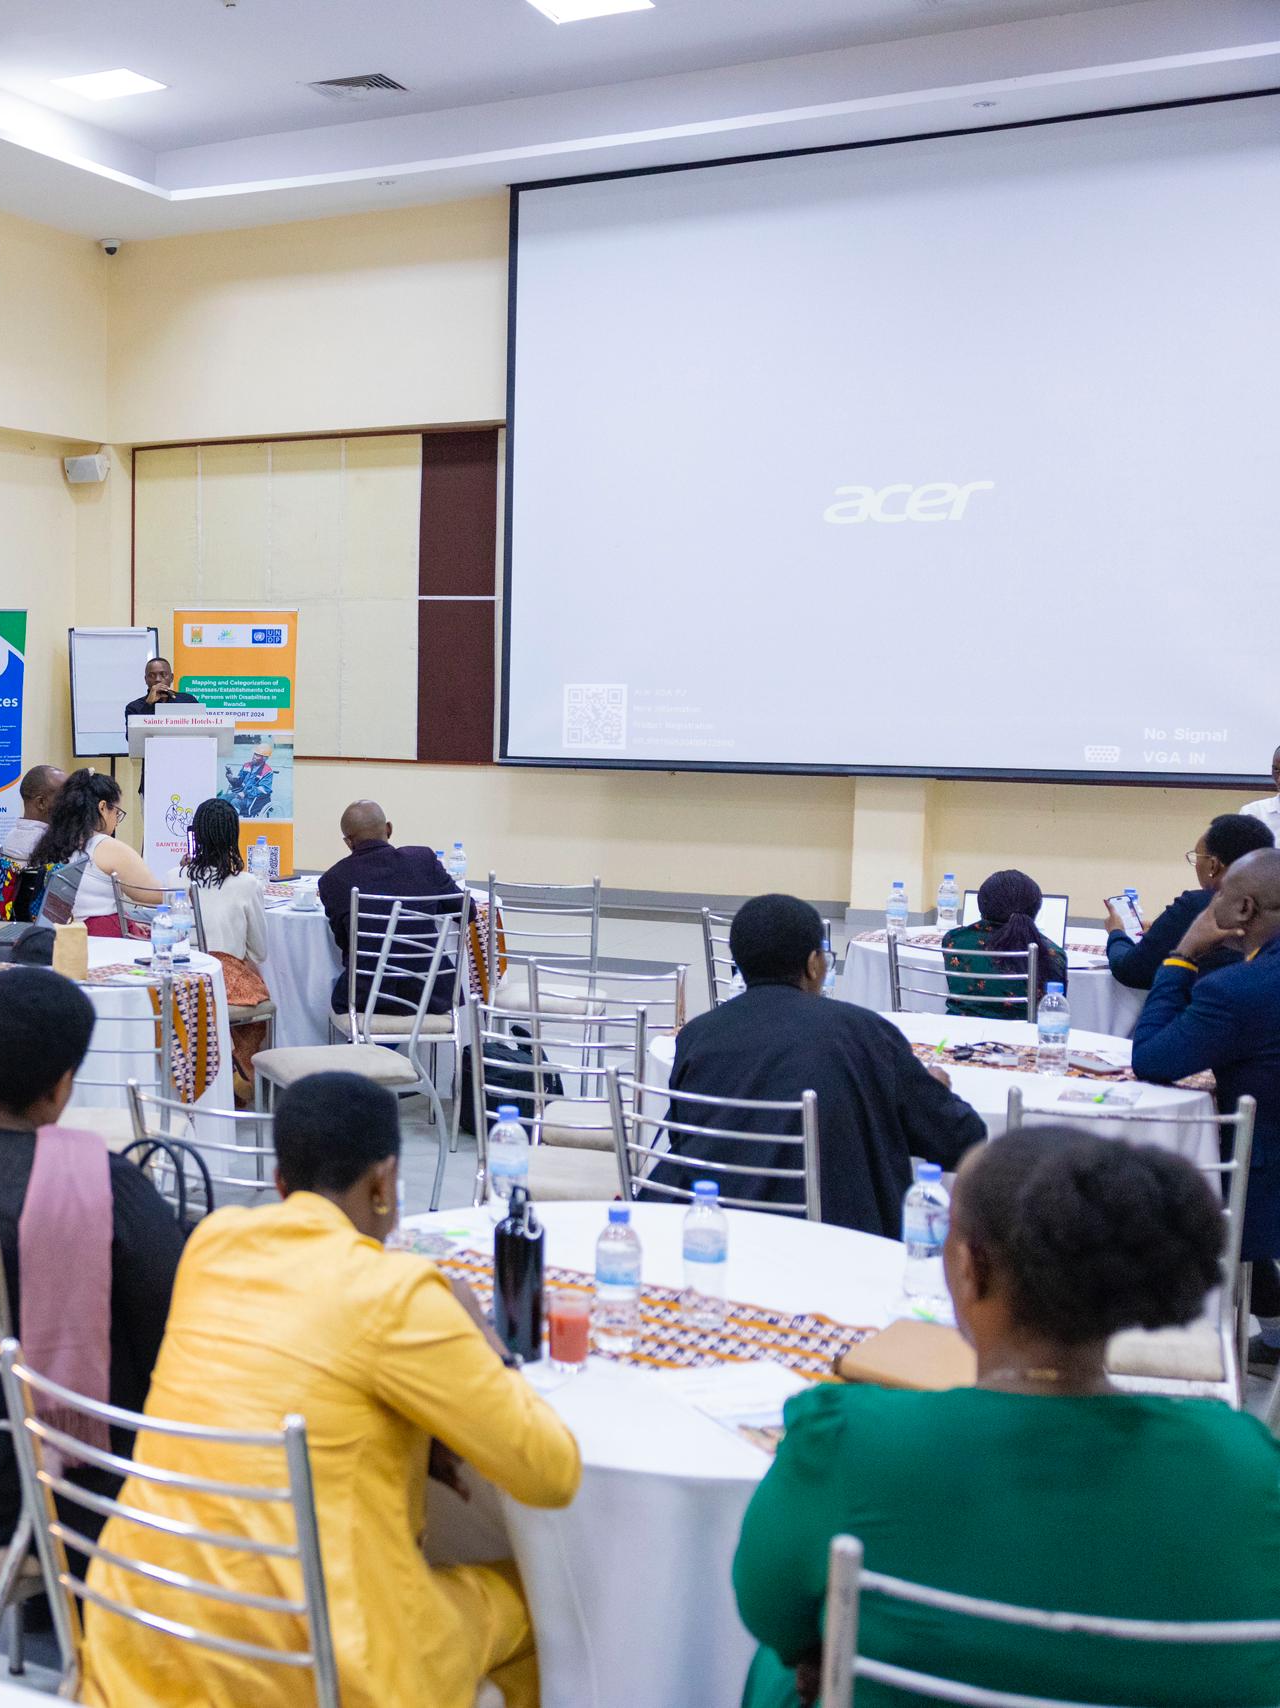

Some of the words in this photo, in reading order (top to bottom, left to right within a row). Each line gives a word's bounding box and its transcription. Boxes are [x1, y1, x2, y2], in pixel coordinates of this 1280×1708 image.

[823, 481, 995, 524] acer
[1144, 728, 1167, 741] No
[1173, 728, 1228, 744] Signal
[1143, 751, 1182, 764] VGA
[1189, 752, 1206, 764] IN
